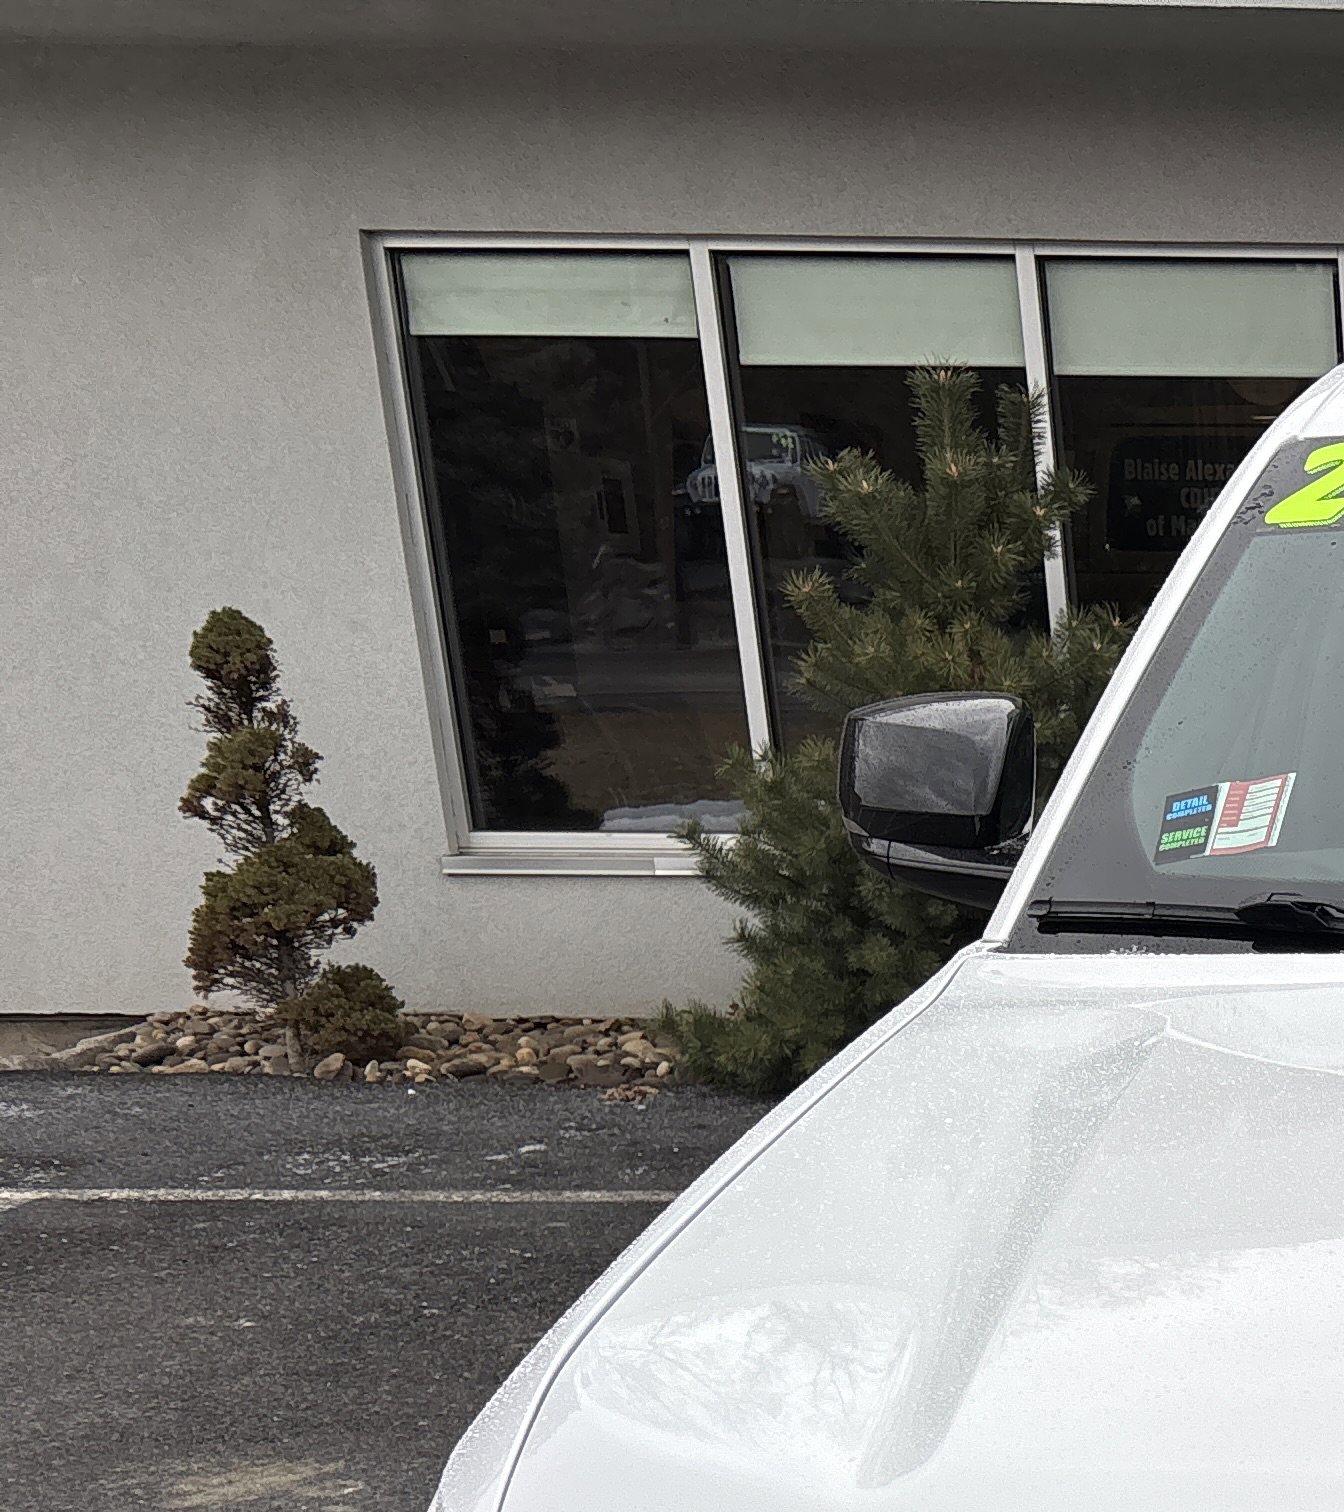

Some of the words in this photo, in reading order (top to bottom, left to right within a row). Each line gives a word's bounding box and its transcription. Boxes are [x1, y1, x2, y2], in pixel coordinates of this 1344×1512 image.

[1124, 459, 1179, 481] Blaise
[1146, 515, 1164, 536] of
[1166, 804, 1212, 820] COMPLETED
[1172, 794, 1209, 813] DETAIL
[1159, 836, 1205, 852] COMPLETED
[1161, 825, 1208, 844] SERVICE
